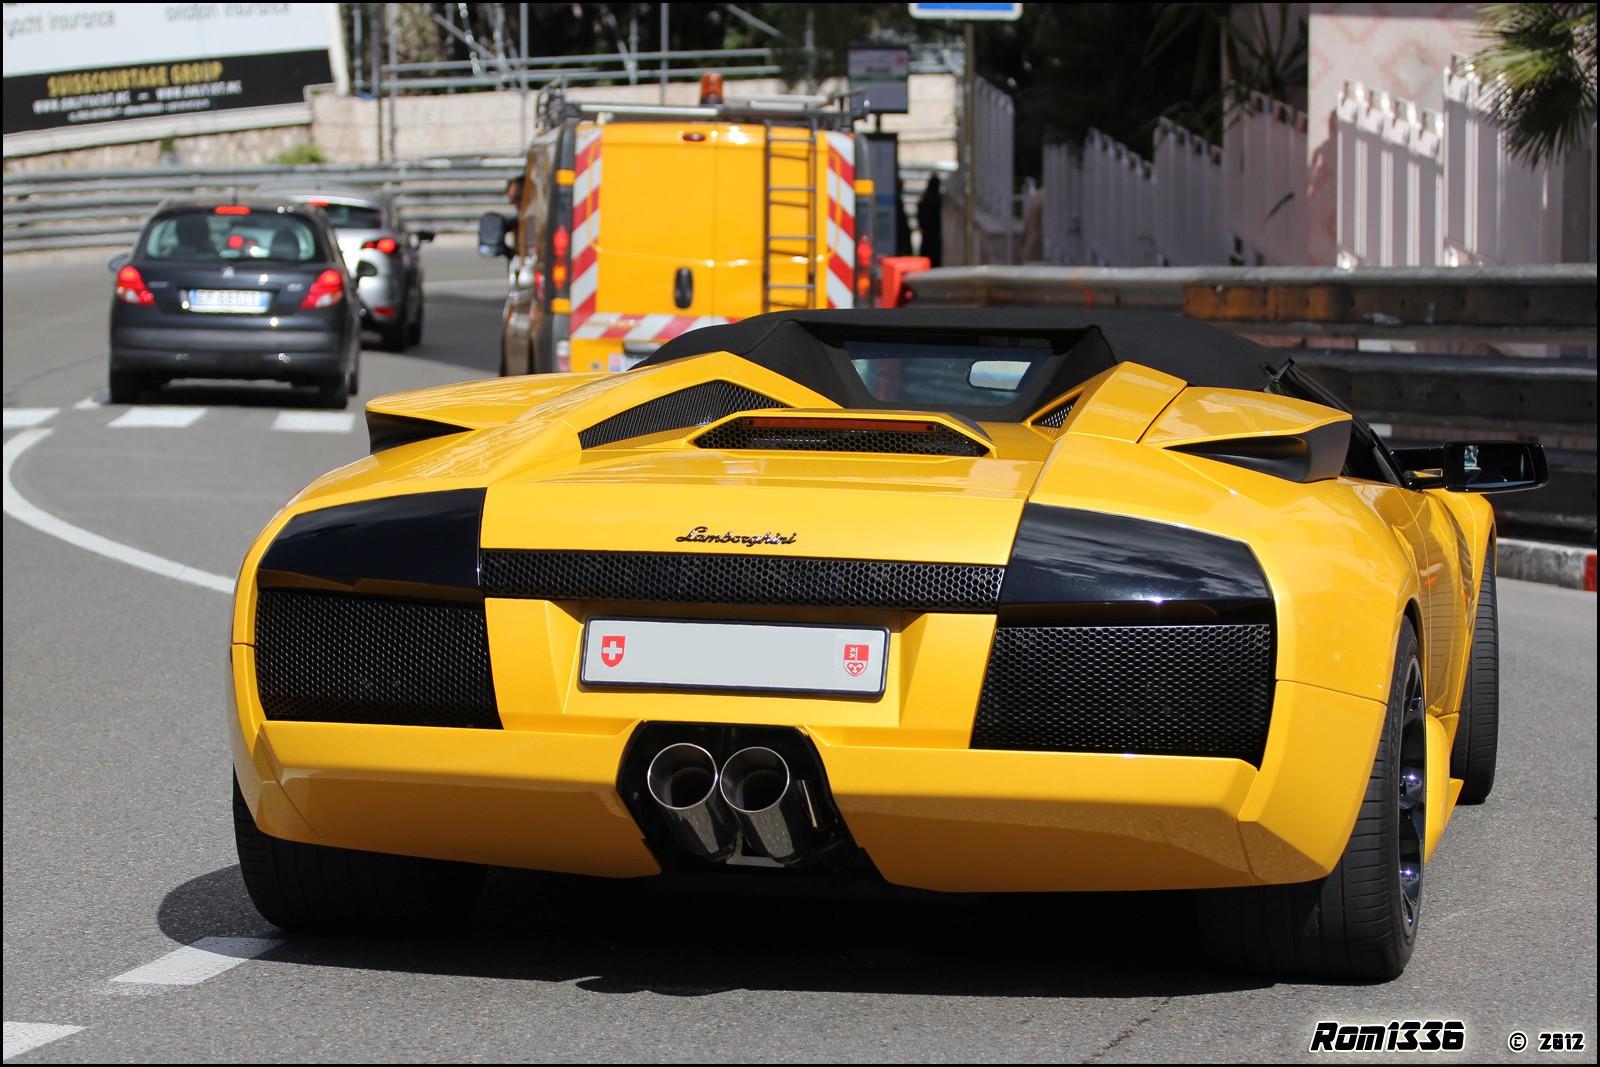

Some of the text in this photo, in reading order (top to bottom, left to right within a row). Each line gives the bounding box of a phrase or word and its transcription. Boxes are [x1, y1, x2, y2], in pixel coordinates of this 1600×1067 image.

[49, 10, 116, 32] insurance
[223, 3, 290, 18] insurance
[46, 60, 223, 98] SUISSCOURTAGE GROUP
[676, 526, 797, 547] Lamborghini
